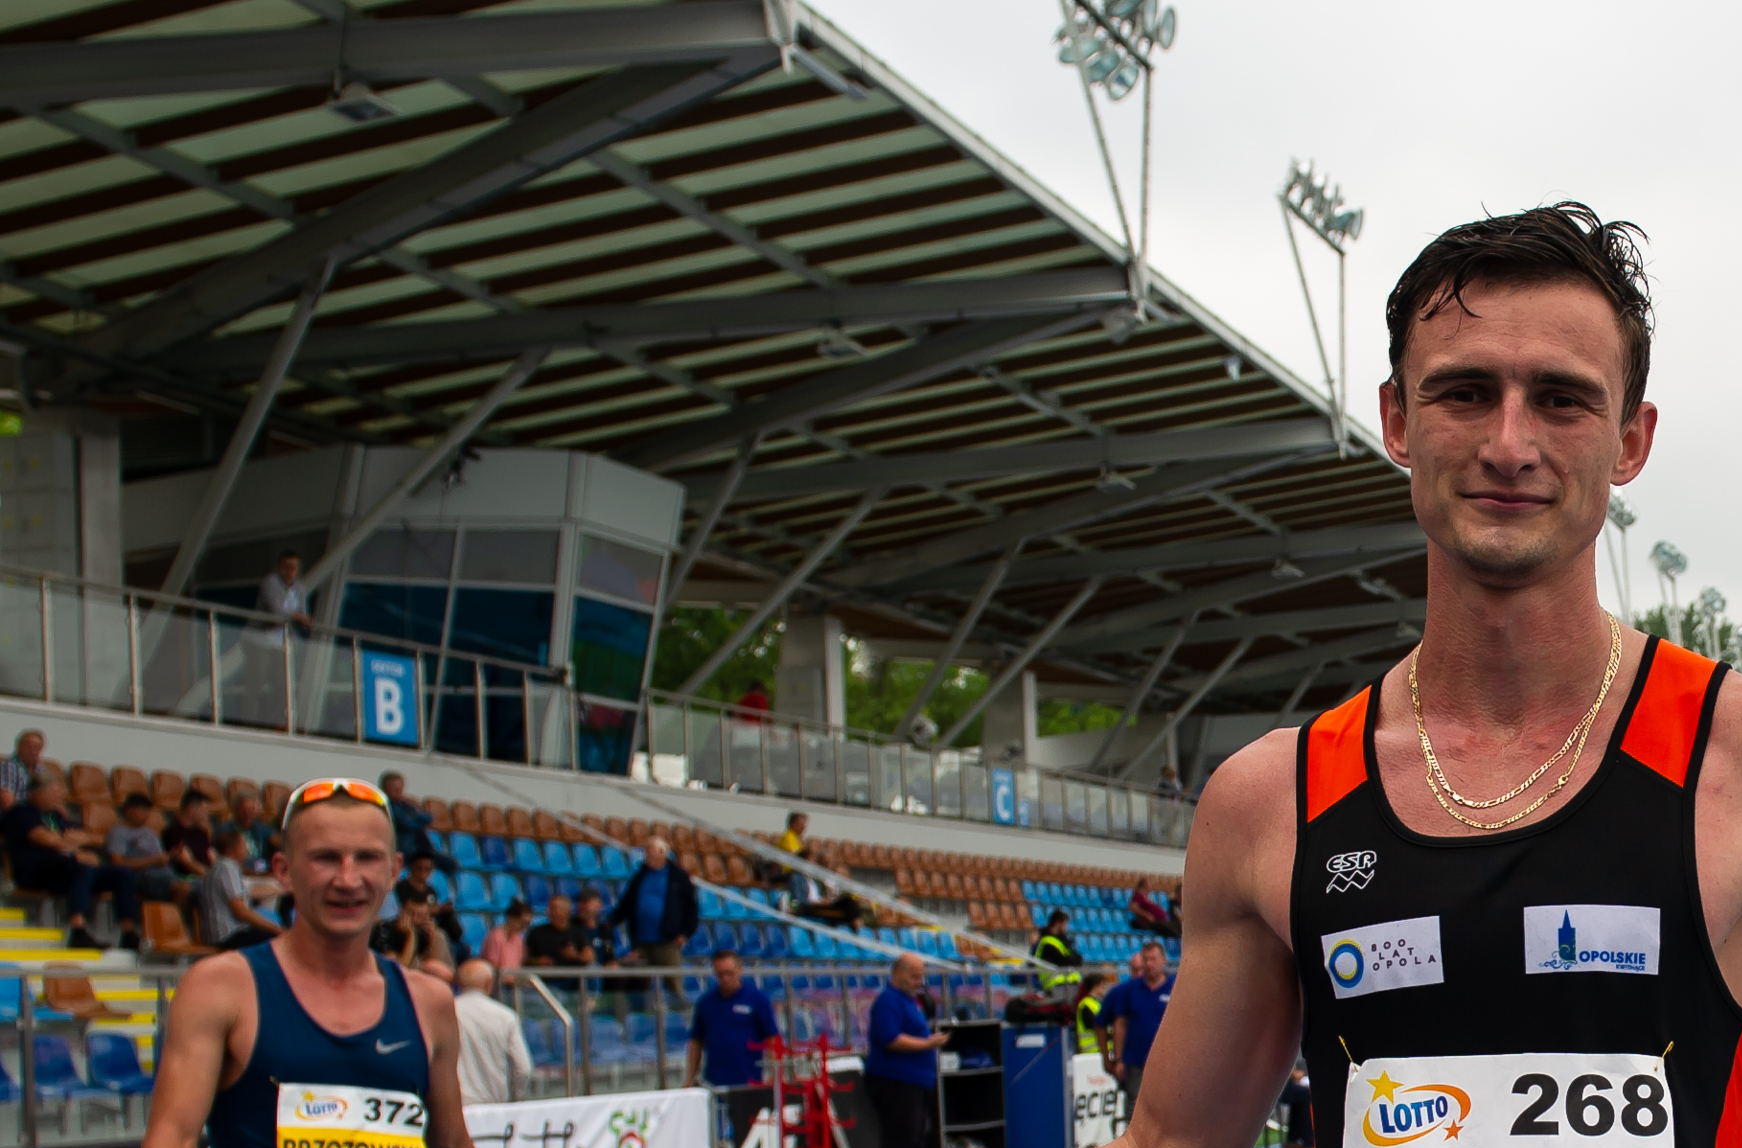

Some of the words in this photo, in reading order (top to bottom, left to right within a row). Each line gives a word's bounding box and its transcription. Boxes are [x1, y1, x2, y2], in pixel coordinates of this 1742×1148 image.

[374, 677, 405, 735] B
[996, 785, 1011, 821] C
[1371, 938, 1406, 952] 800
[1379, 947, 1414, 960] LAT
[1372, 955, 1437, 972] OPOLA
[1579, 951, 1646, 965] OPOLSKIE
[364, 1098, 424, 1126] 372
[1378, 1095, 1449, 1134] LOTTO
[1509, 1073, 1669, 1137] 268
